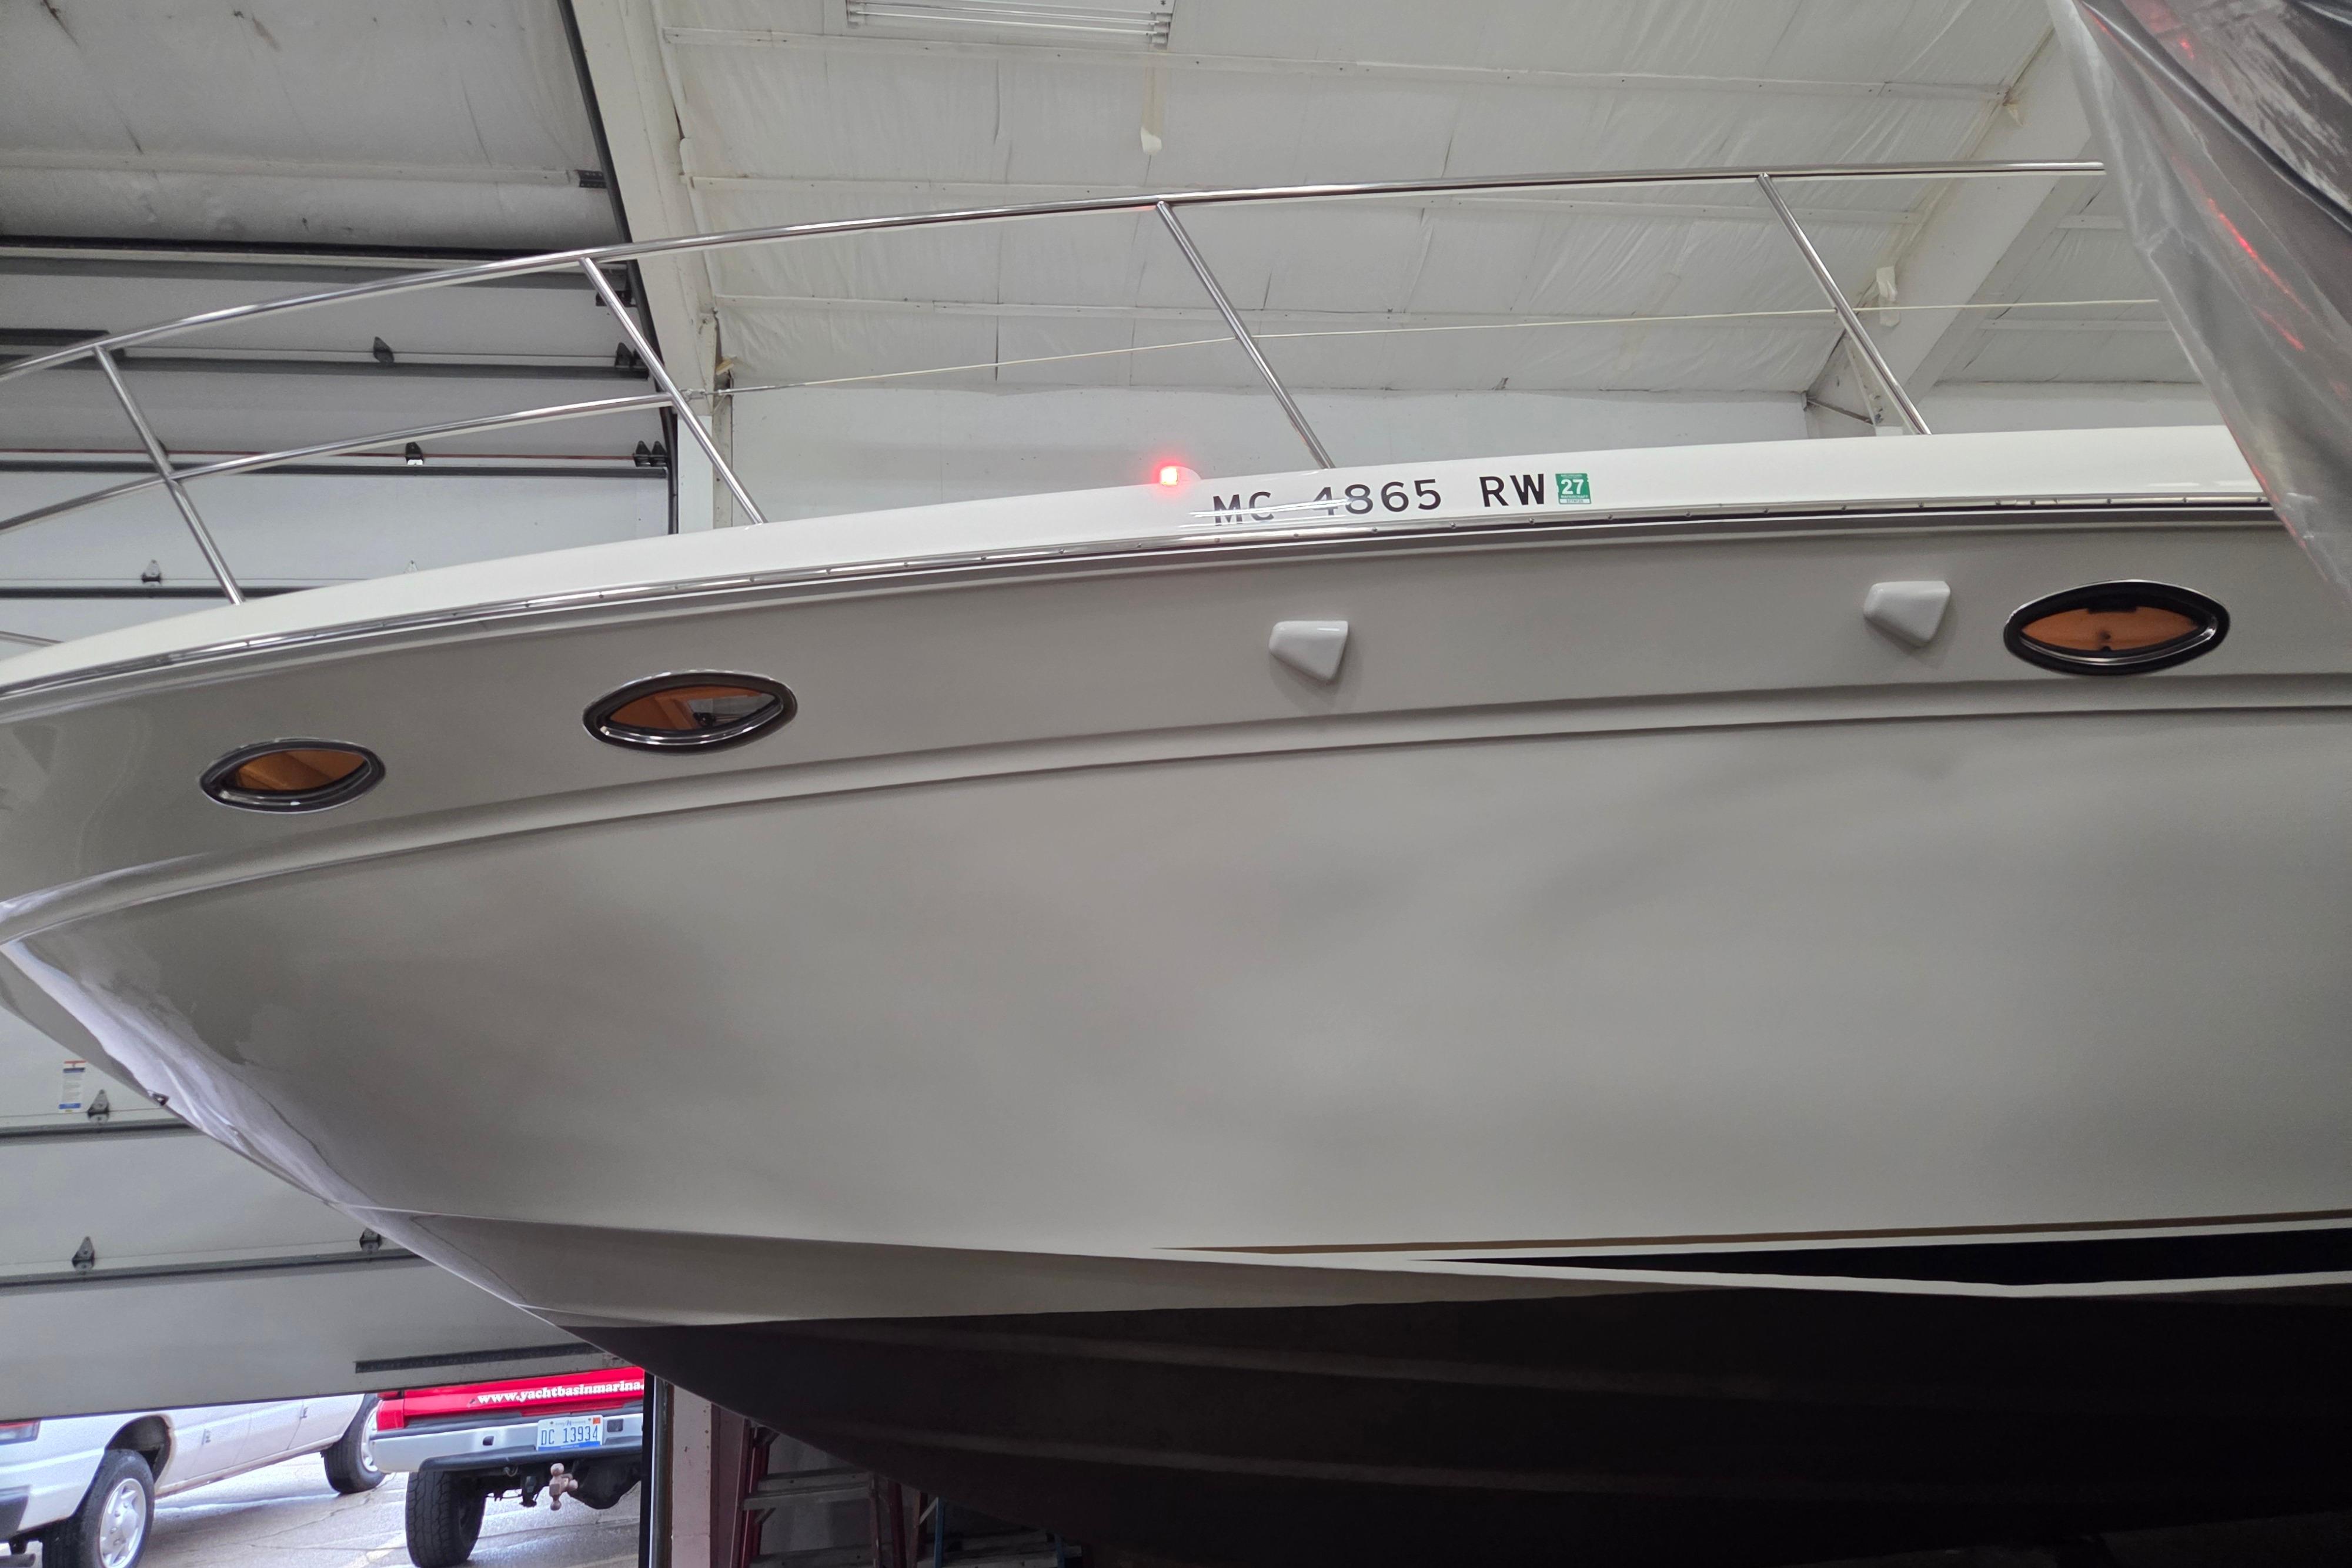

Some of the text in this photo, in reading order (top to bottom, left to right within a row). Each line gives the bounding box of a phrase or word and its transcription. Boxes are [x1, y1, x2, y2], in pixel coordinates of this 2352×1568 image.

[1561, 479, 1584, 494] 27
[1213, 473, 1545, 526] MC 4865 RW
[563, 1425, 598, 1443] 13934
